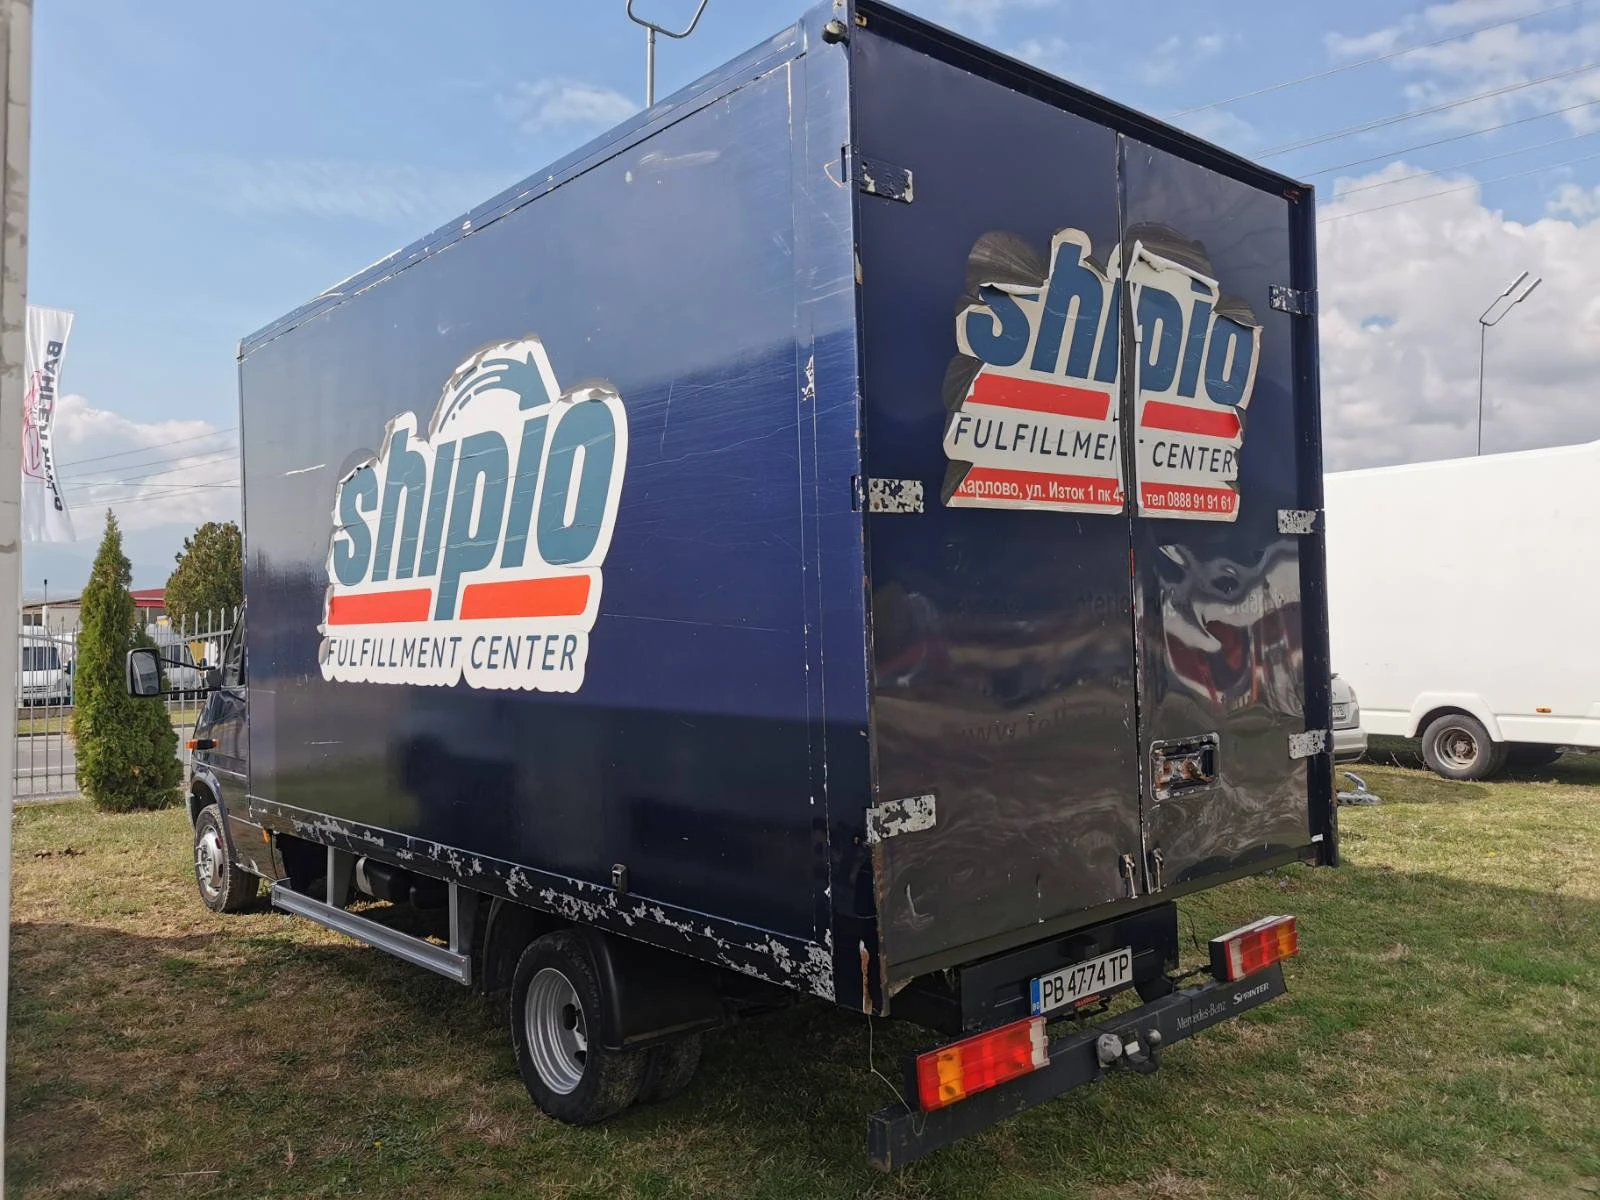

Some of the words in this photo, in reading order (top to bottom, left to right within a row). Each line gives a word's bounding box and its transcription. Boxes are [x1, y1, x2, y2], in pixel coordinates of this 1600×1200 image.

[954, 417, 1144, 461] FULFILLME
[1152, 441, 1233, 473] CENTER
[1026, 483, 1046, 500] ул.
[1049, 481, 1085, 500] Изток
[1088, 484, 1094, 501] 1
[1146, 494, 1165, 506] тел
[1167, 491, 1192, 508] 0888
[1193, 494, 1205, 509] 91
[1207, 494, 1219, 510] 91
[1221, 495, 1232, 510] 61
[327, 636, 462, 669] FULFILLMENT
[471, 634, 578, 671] CENTER
[1043, 976, 1064, 1008] PB
[1067, 961, 1106, 996] 4774
[1109, 954, 1129, 982] TP
